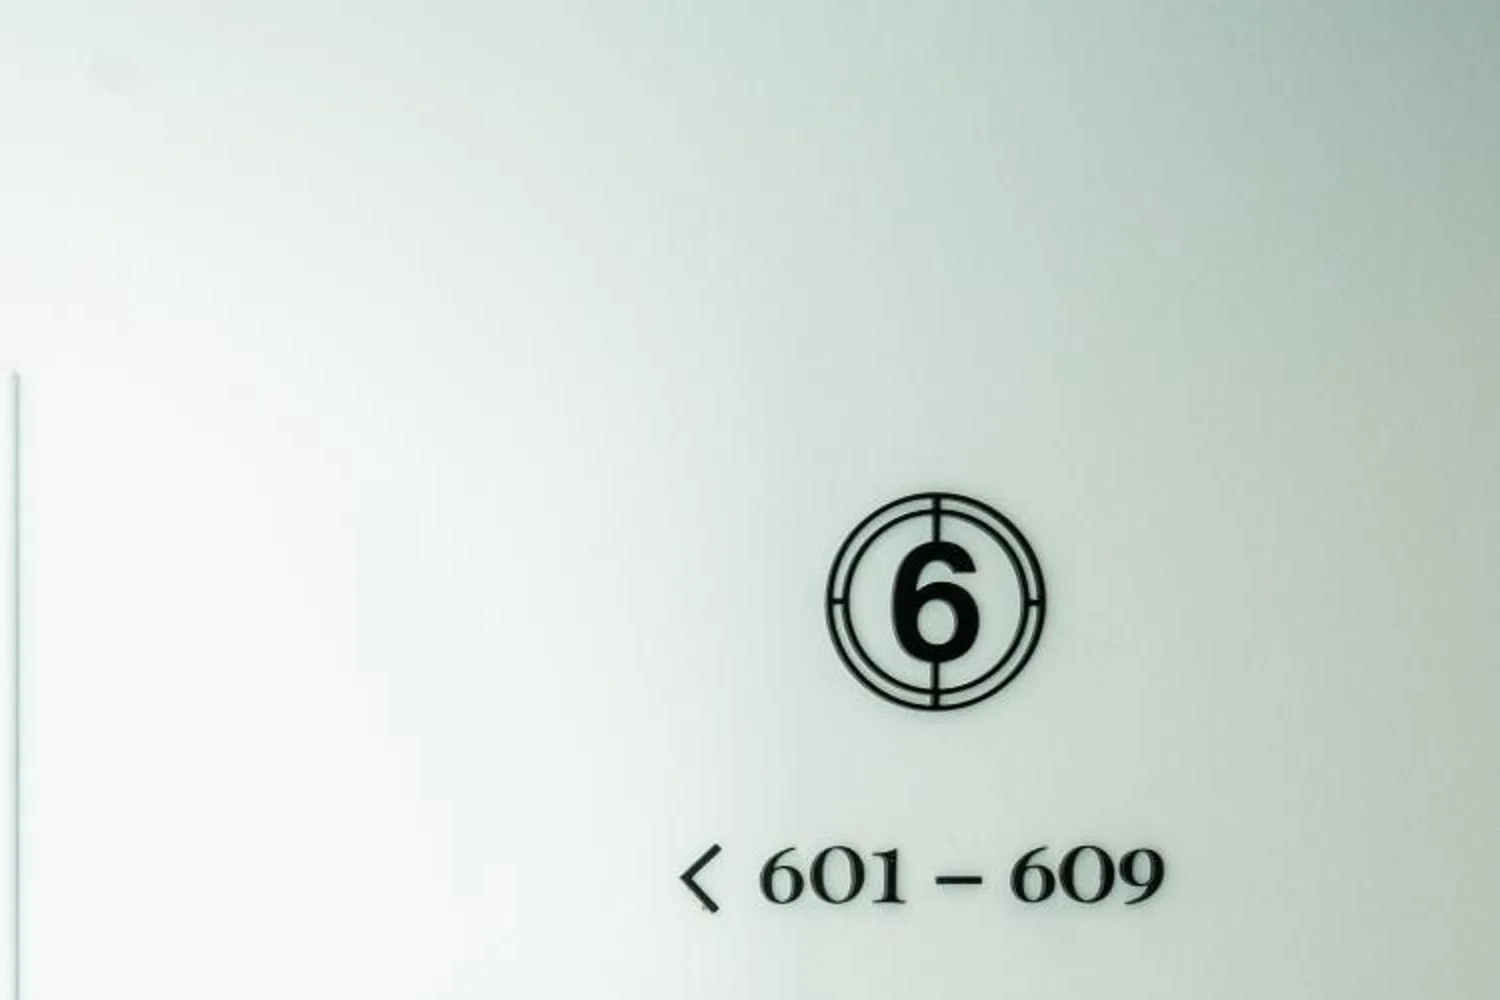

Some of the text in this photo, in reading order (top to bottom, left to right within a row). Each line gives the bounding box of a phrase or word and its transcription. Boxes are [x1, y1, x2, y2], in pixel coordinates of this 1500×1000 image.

[891, 540, 981, 663] 6
[759, 845, 906, 905] 601
[1009, 845, 1166, 906] 609
